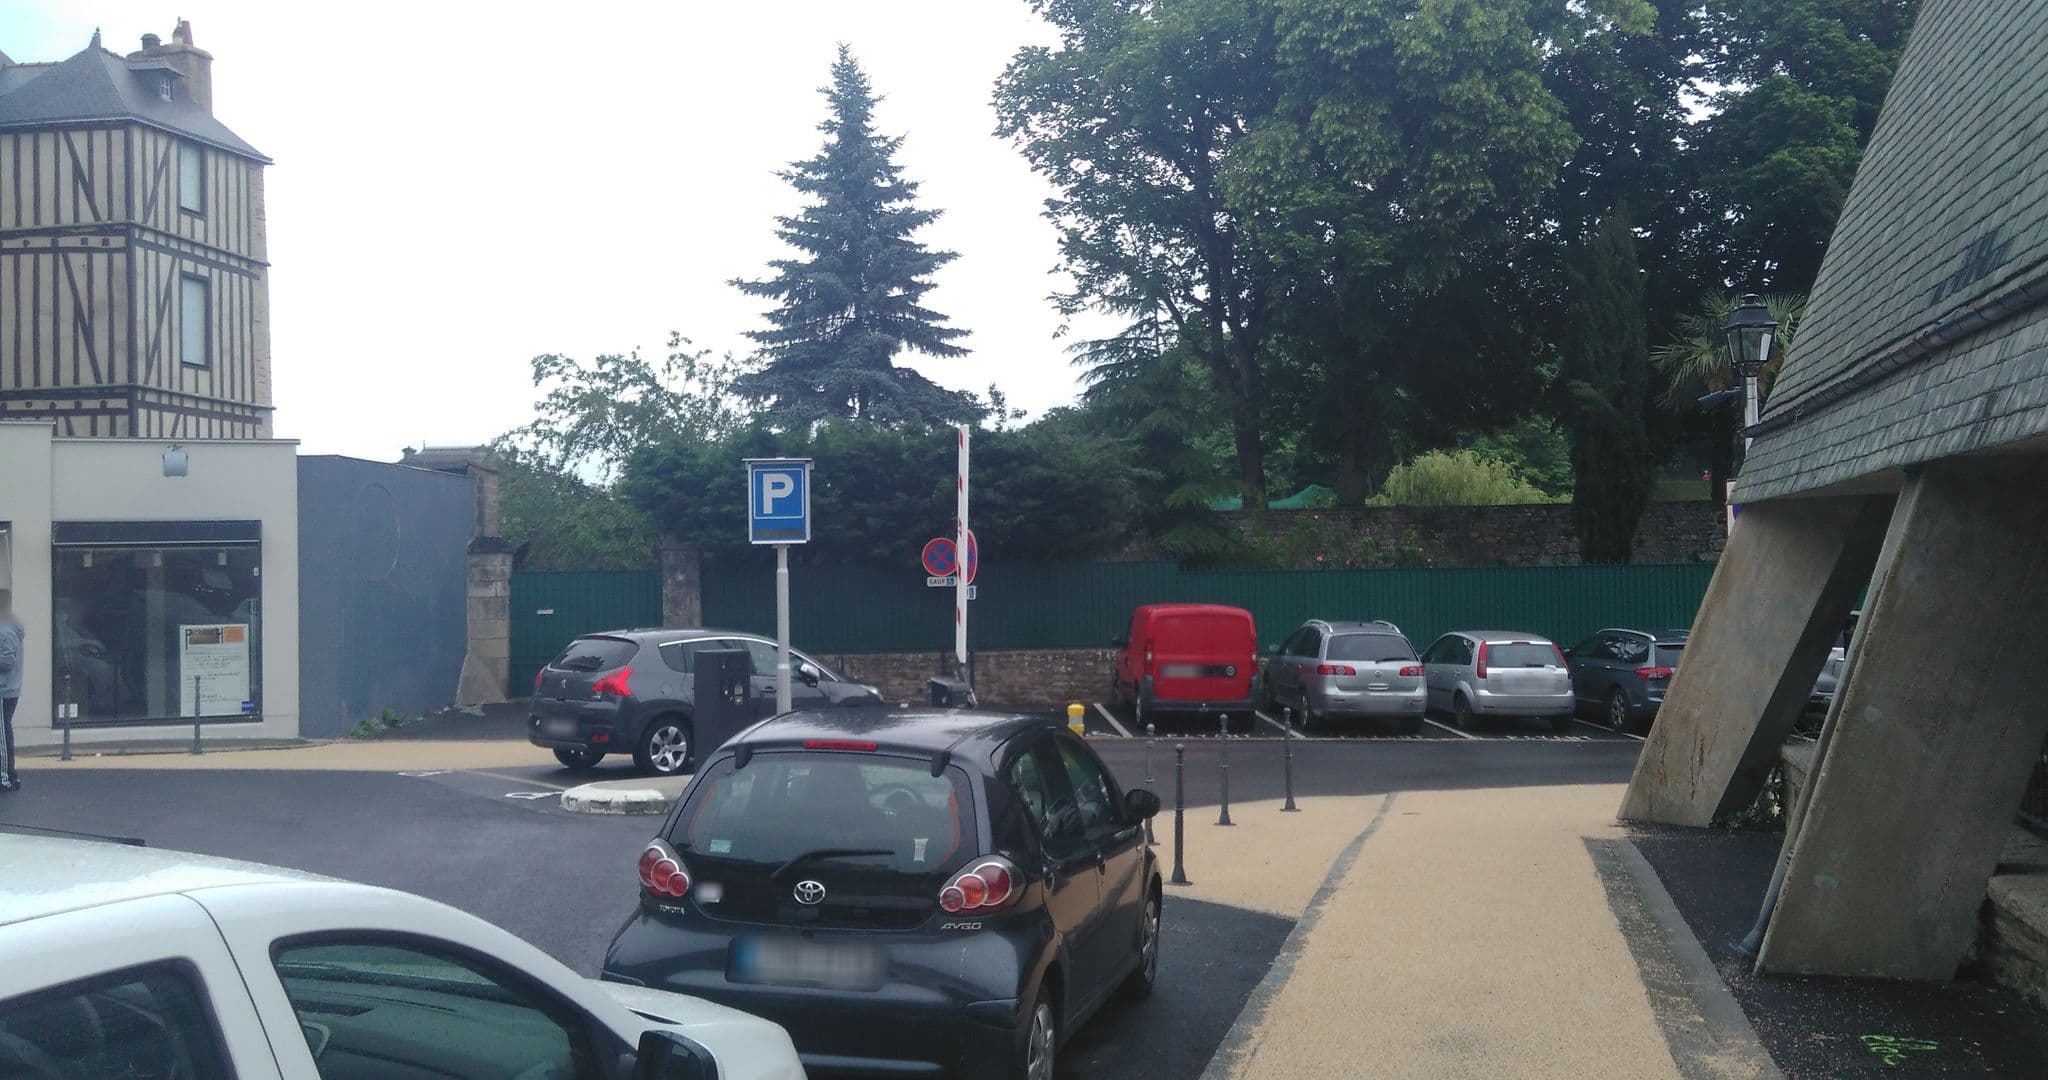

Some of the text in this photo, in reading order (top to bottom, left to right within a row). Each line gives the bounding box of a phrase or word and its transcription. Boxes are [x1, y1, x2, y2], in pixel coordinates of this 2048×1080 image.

[762, 473, 794, 515] P
[658, 904, 685, 915] TOYOTA
[940, 922, 983, 930] AYGO
